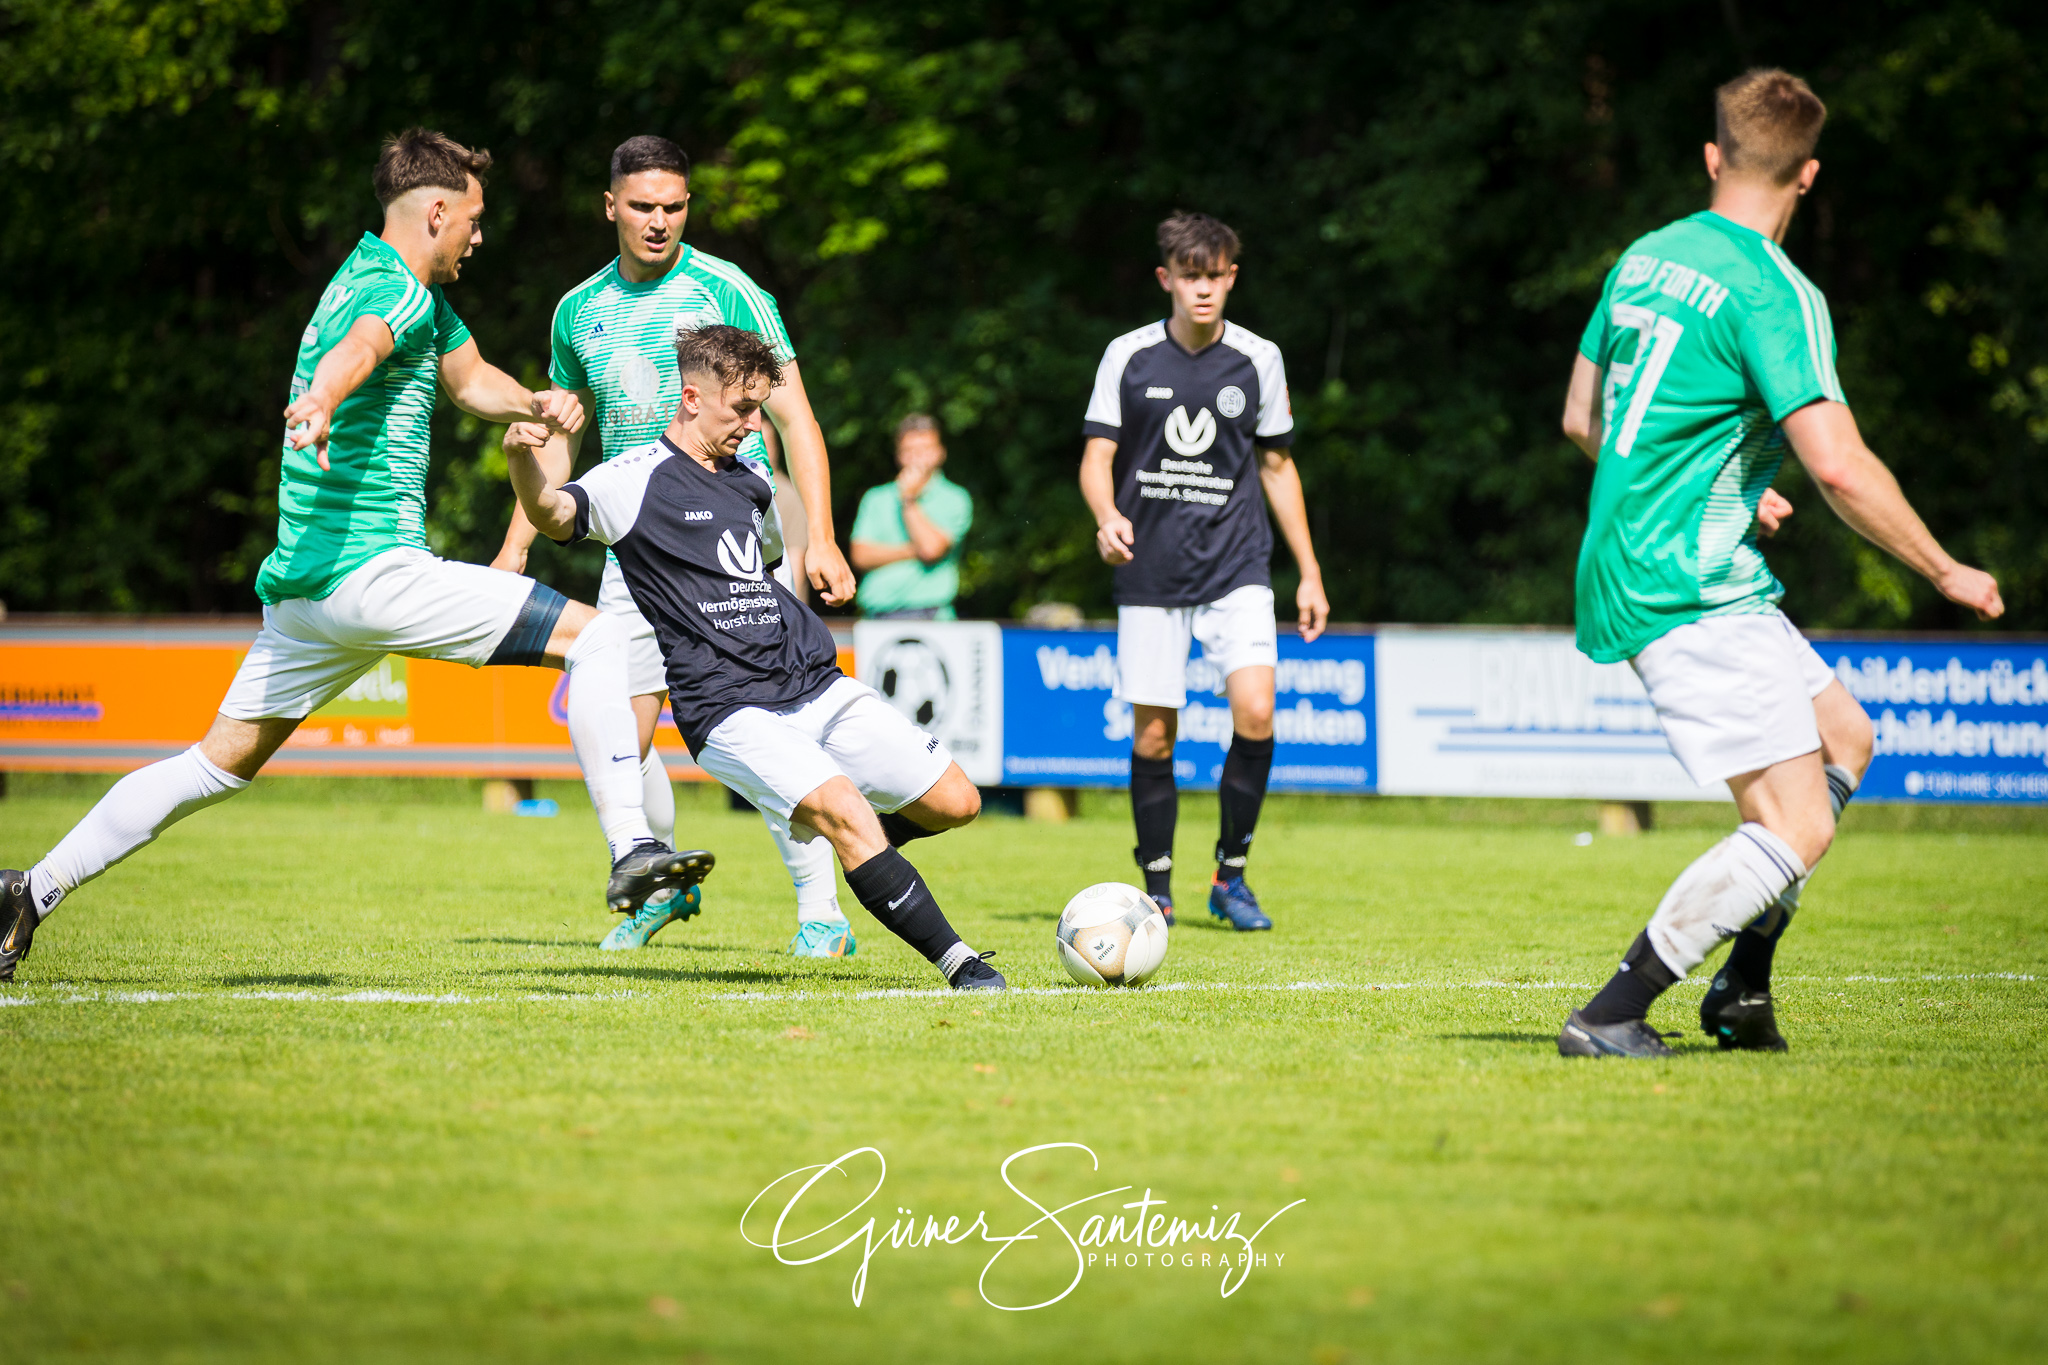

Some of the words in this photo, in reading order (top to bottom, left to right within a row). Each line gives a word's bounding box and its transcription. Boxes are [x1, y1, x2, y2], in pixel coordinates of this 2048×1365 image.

[684, 511, 713, 521] JAKO
[728, 581, 772, 594] Deutsche
[713, 614, 747, 630] Horst
[1871, 708, 2048, 768] hilderun
